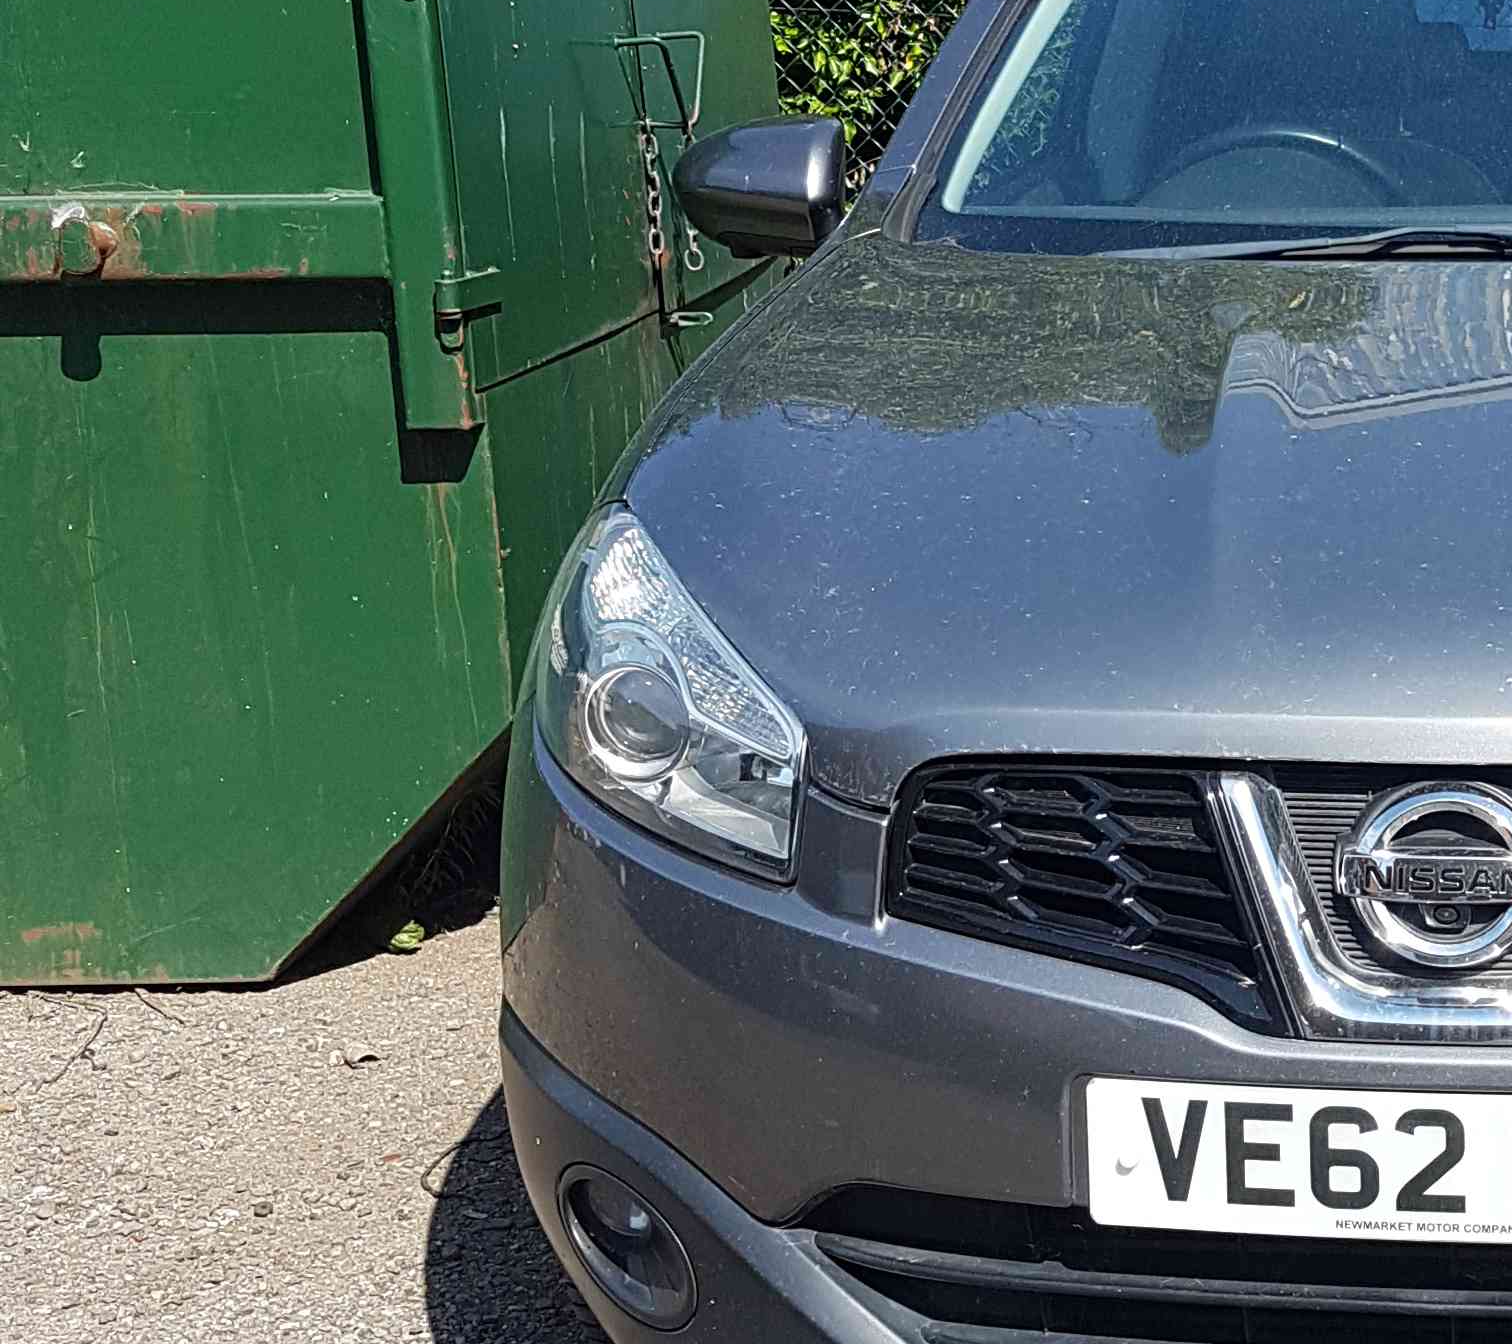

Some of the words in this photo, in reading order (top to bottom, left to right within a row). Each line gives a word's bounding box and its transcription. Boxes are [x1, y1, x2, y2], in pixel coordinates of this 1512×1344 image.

[1142, 1097, 1466, 1213] VE62
[1335, 1220, 1413, 1232] NEWMARKET
[1416, 1222, 1460, 1233] MOTOR
